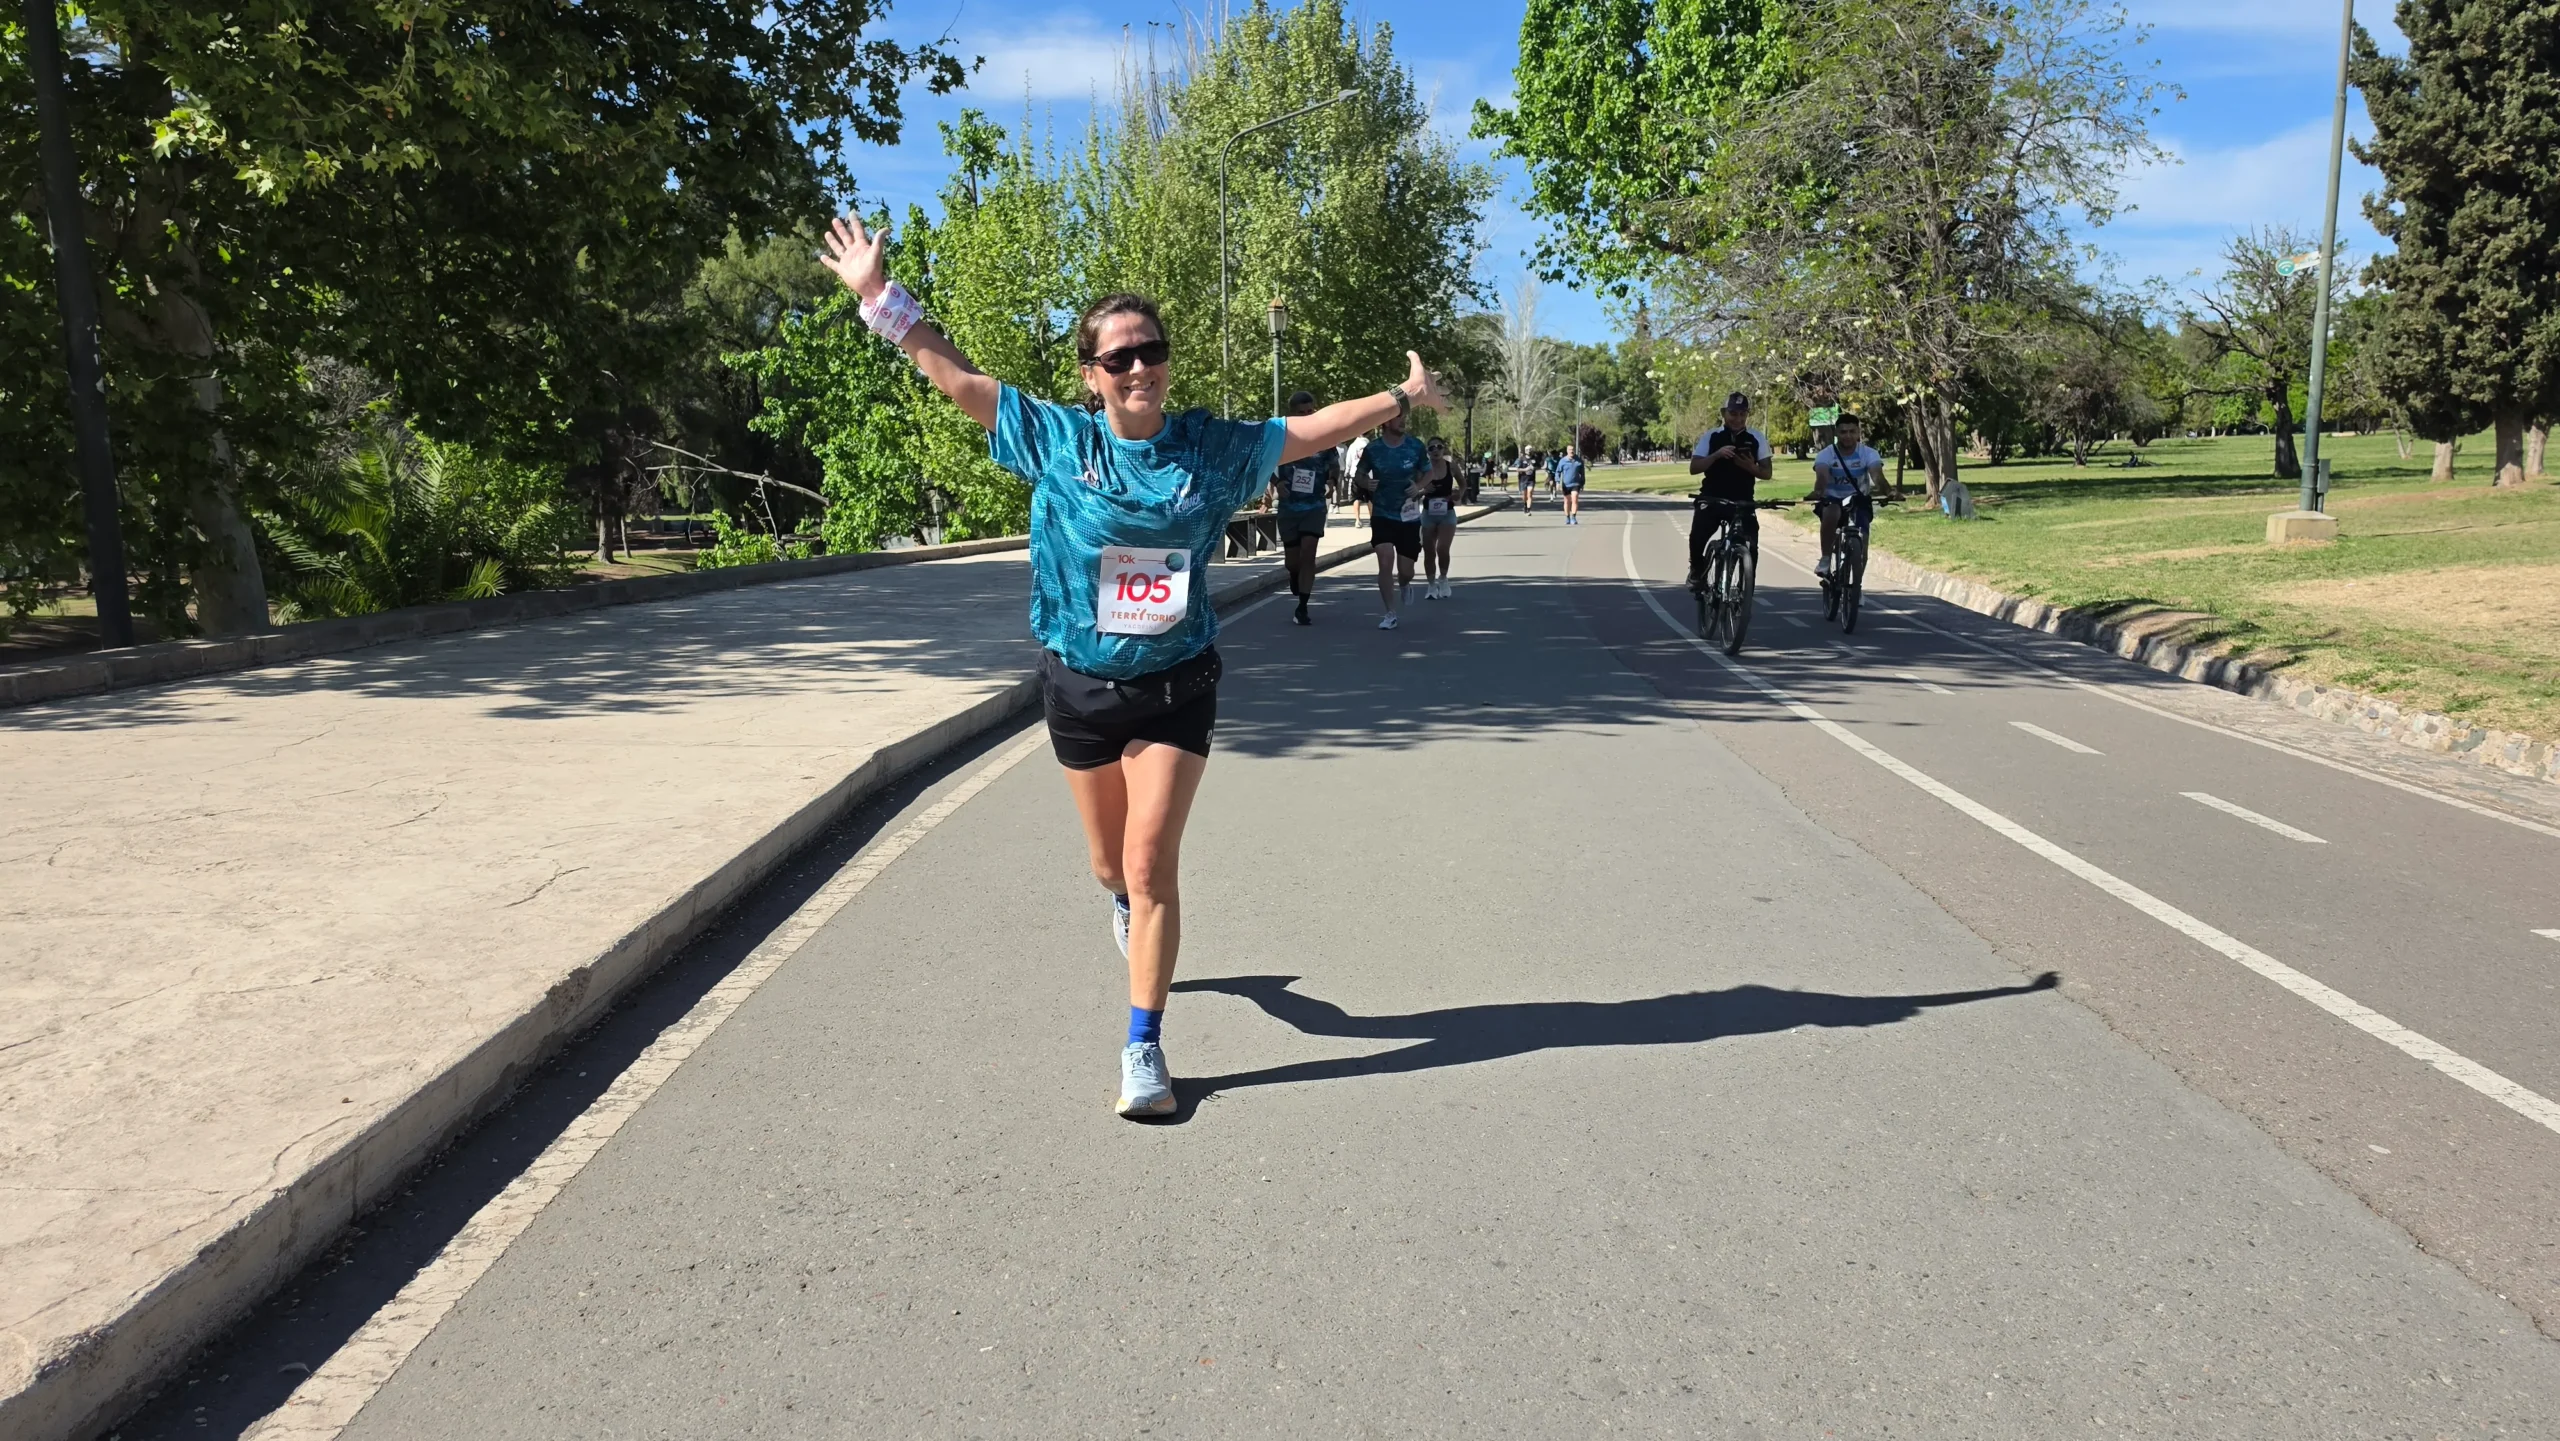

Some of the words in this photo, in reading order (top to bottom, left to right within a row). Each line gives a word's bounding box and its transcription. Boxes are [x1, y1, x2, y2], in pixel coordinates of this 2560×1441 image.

[1295, 475, 1312, 485] 252
[1117, 554, 1136, 564] 10k
[1115, 572, 1172, 603] 105
